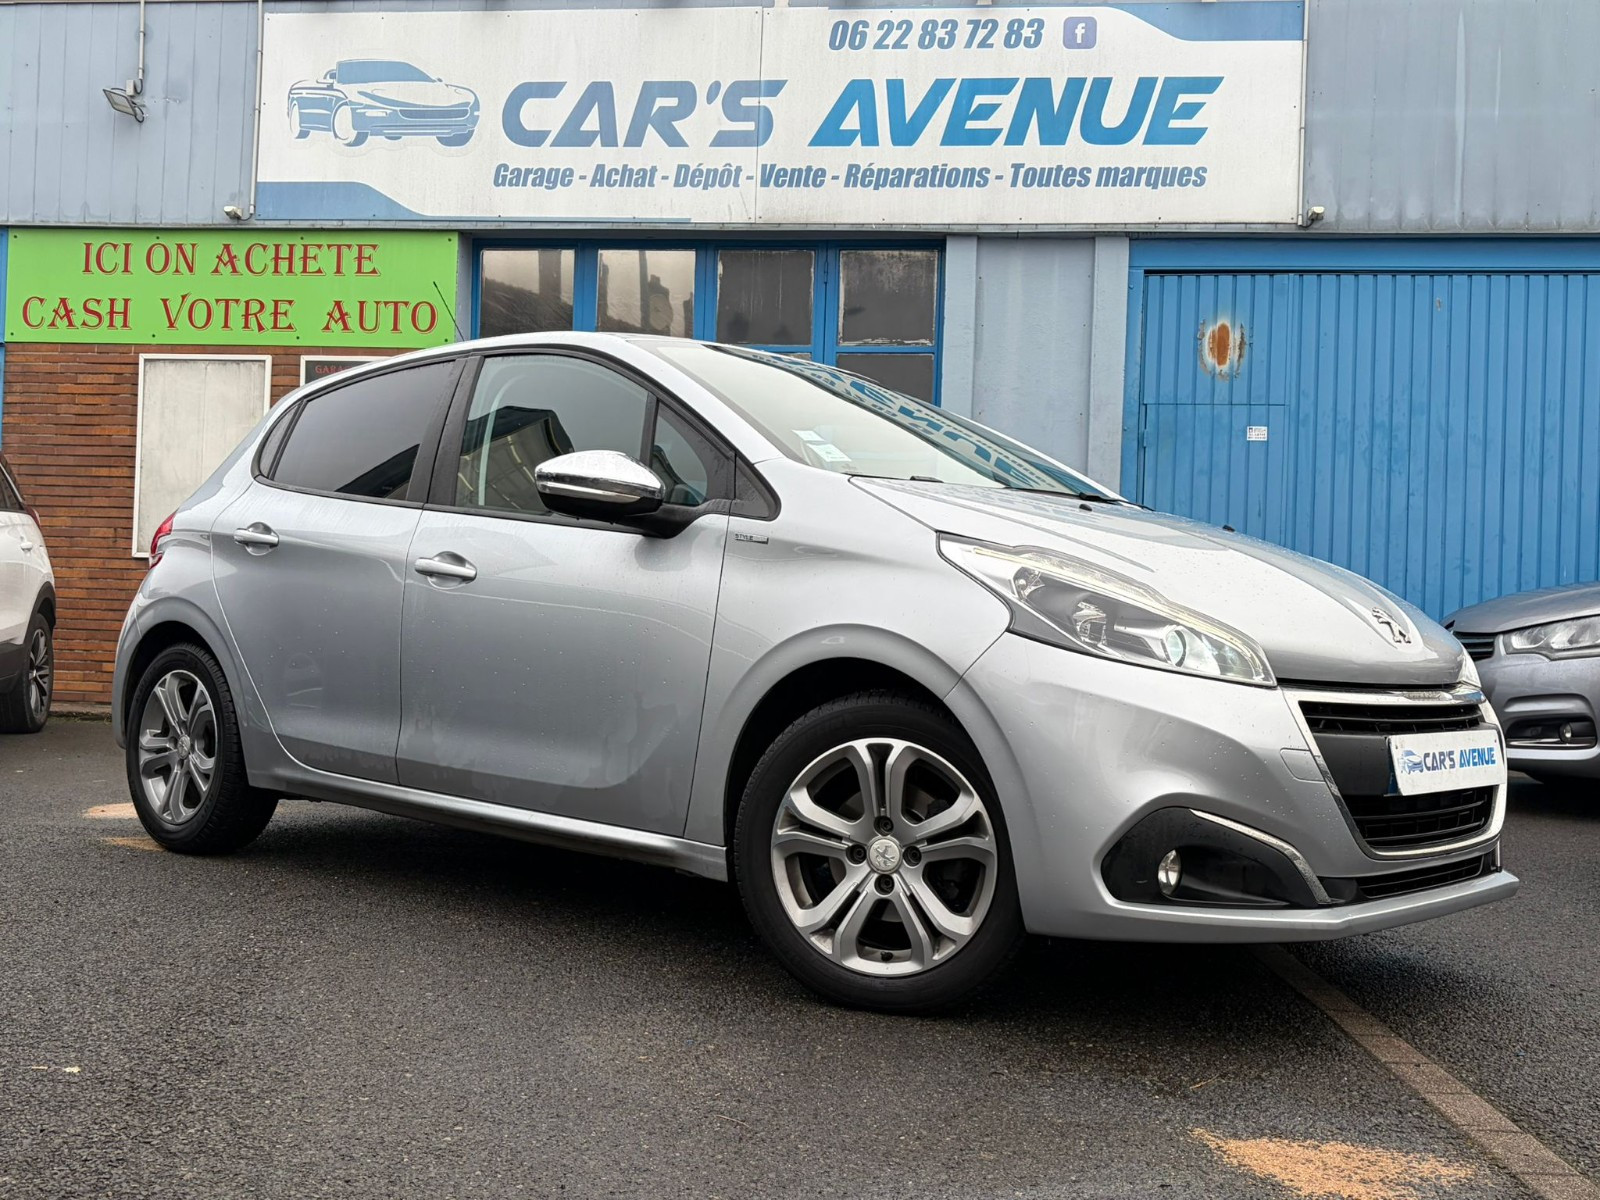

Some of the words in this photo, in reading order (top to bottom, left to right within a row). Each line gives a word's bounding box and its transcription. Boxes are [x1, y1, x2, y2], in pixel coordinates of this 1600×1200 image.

[829, 20, 870, 50] 06
[873, 20, 913, 50] 22
[917, 19, 959, 49] 83
[963, 19, 999, 49] 72
[1003, 18, 1045, 48] 83
[502, 79, 788, 148] CAR'S
[807, 76, 1224, 147] AVENUE
[493, 163, 574, 190] Garage
[590, 164, 658, 188] Achat
[673, 162, 743, 190] Dépôt
[759, 163, 826, 187] Vente
[843, 162, 991, 190] Réparations
[1010, 162, 1091, 188] Toutes
[1095, 165, 1208, 189] marques
[82, 242, 132, 275] ICI
[145, 243, 198, 275] ON
[210, 243, 381, 276] ACHETE
[22, 296, 133, 330] CASH
[160, 292, 296, 333] VOTRE
[321, 300, 439, 333] AUTO
[735, 533, 753, 541] STYLE
[1423, 750, 1456, 771] CAR'S
[1459, 747, 1496, 768] AVENUE
